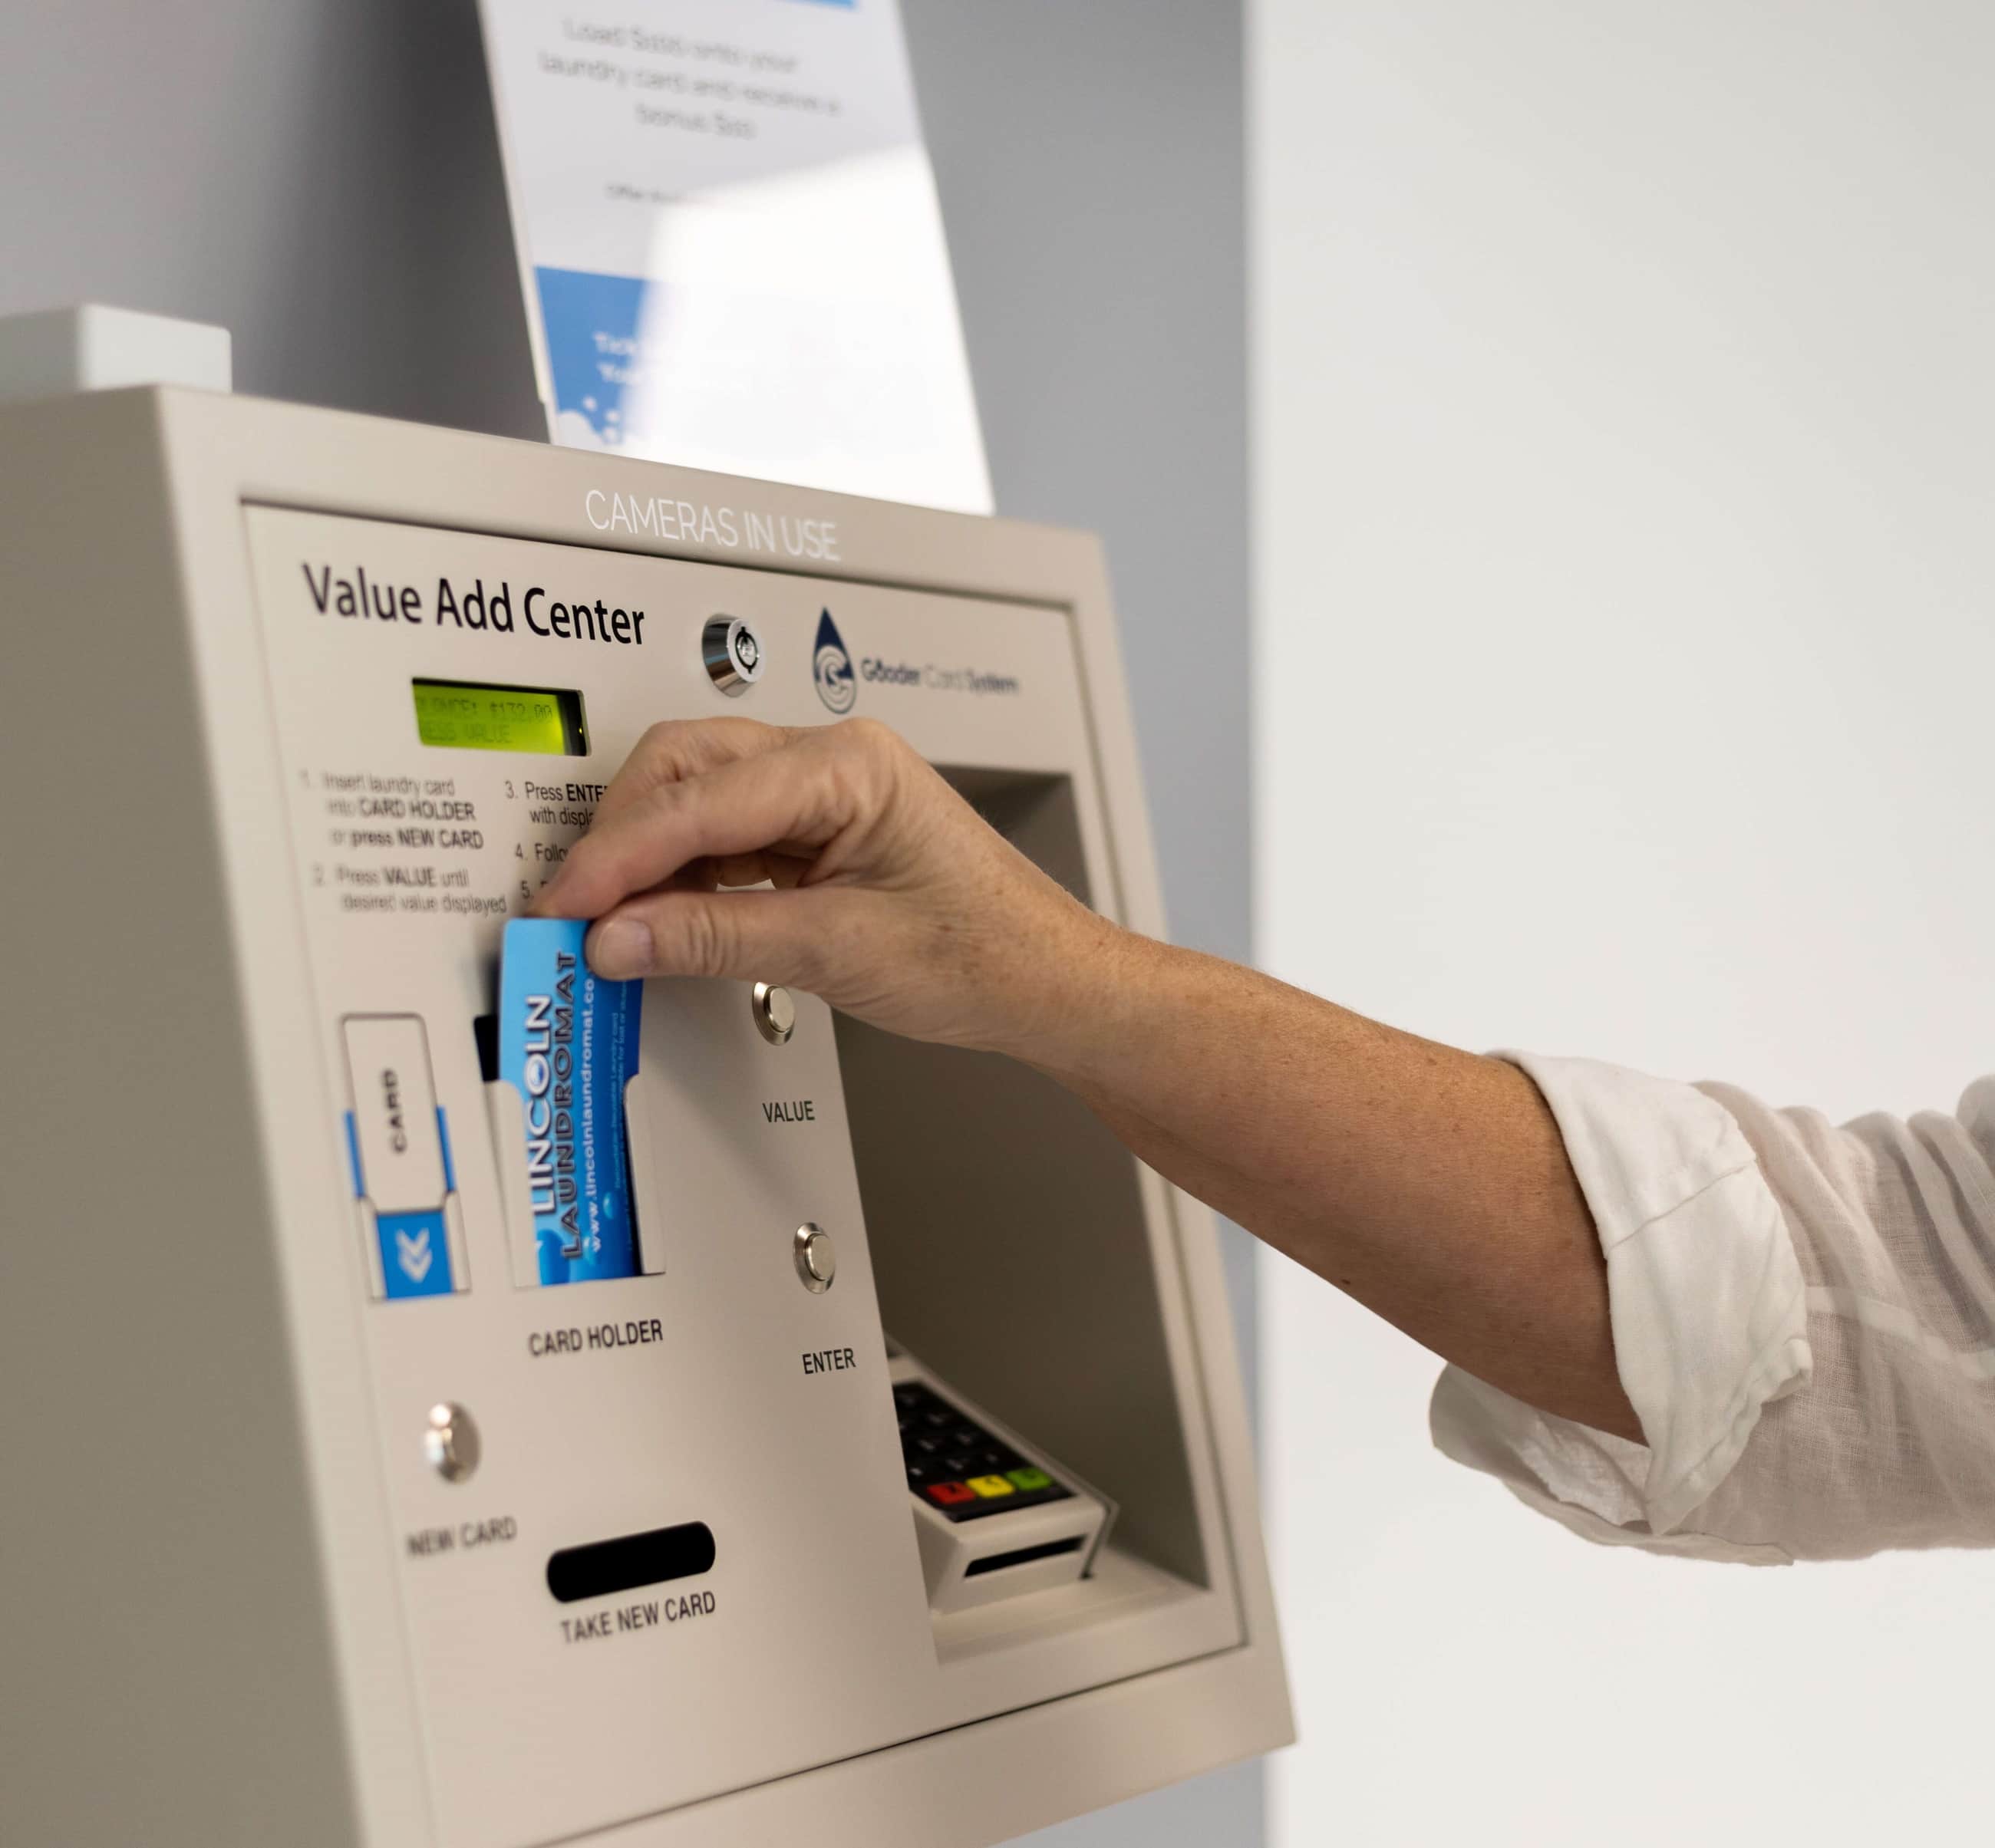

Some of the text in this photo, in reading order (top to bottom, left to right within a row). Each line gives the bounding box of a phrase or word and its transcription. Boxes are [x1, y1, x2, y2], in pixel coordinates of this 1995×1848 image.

[585, 489, 842, 562] CAMERAS IN USE
[302, 562, 645, 645] Value Add Center
[322, 772, 365, 791] Insert
[369, 774, 420, 796] laundry
[424, 776, 455, 796] card
[525, 781, 563, 801] Press
[566, 783, 608, 802] ENTE
[359, 799, 406, 819] CARD
[409, 801, 476, 822] HOLDER
[530, 807, 556, 824] with
[351, 829, 393, 847] press
[396, 828, 435, 848] NEW
[438, 829, 484, 850] CARD
[335, 868, 379, 885] Press
[384, 867, 437, 888] VALUE
[441, 868, 470, 887] until
[400, 896, 437, 913] value
[441, 895, 508, 916] displayed
[381, 1069, 408, 1154] CARD
[524, 994, 557, 1217] LINCOLN
[553, 950, 583, 1260] LAUNDROMAT
[580, 977, 602, 1253] www.lincolnlaundromat.co
[762, 1100, 816, 1123] VALUE
[527, 1318, 664, 1357] CARD HOLDER
[802, 1347, 856, 1375] ENTER
[407, 1516, 518, 1558] NEW CARD
[560, 1589, 716, 1645] TAKE NEW CARD
